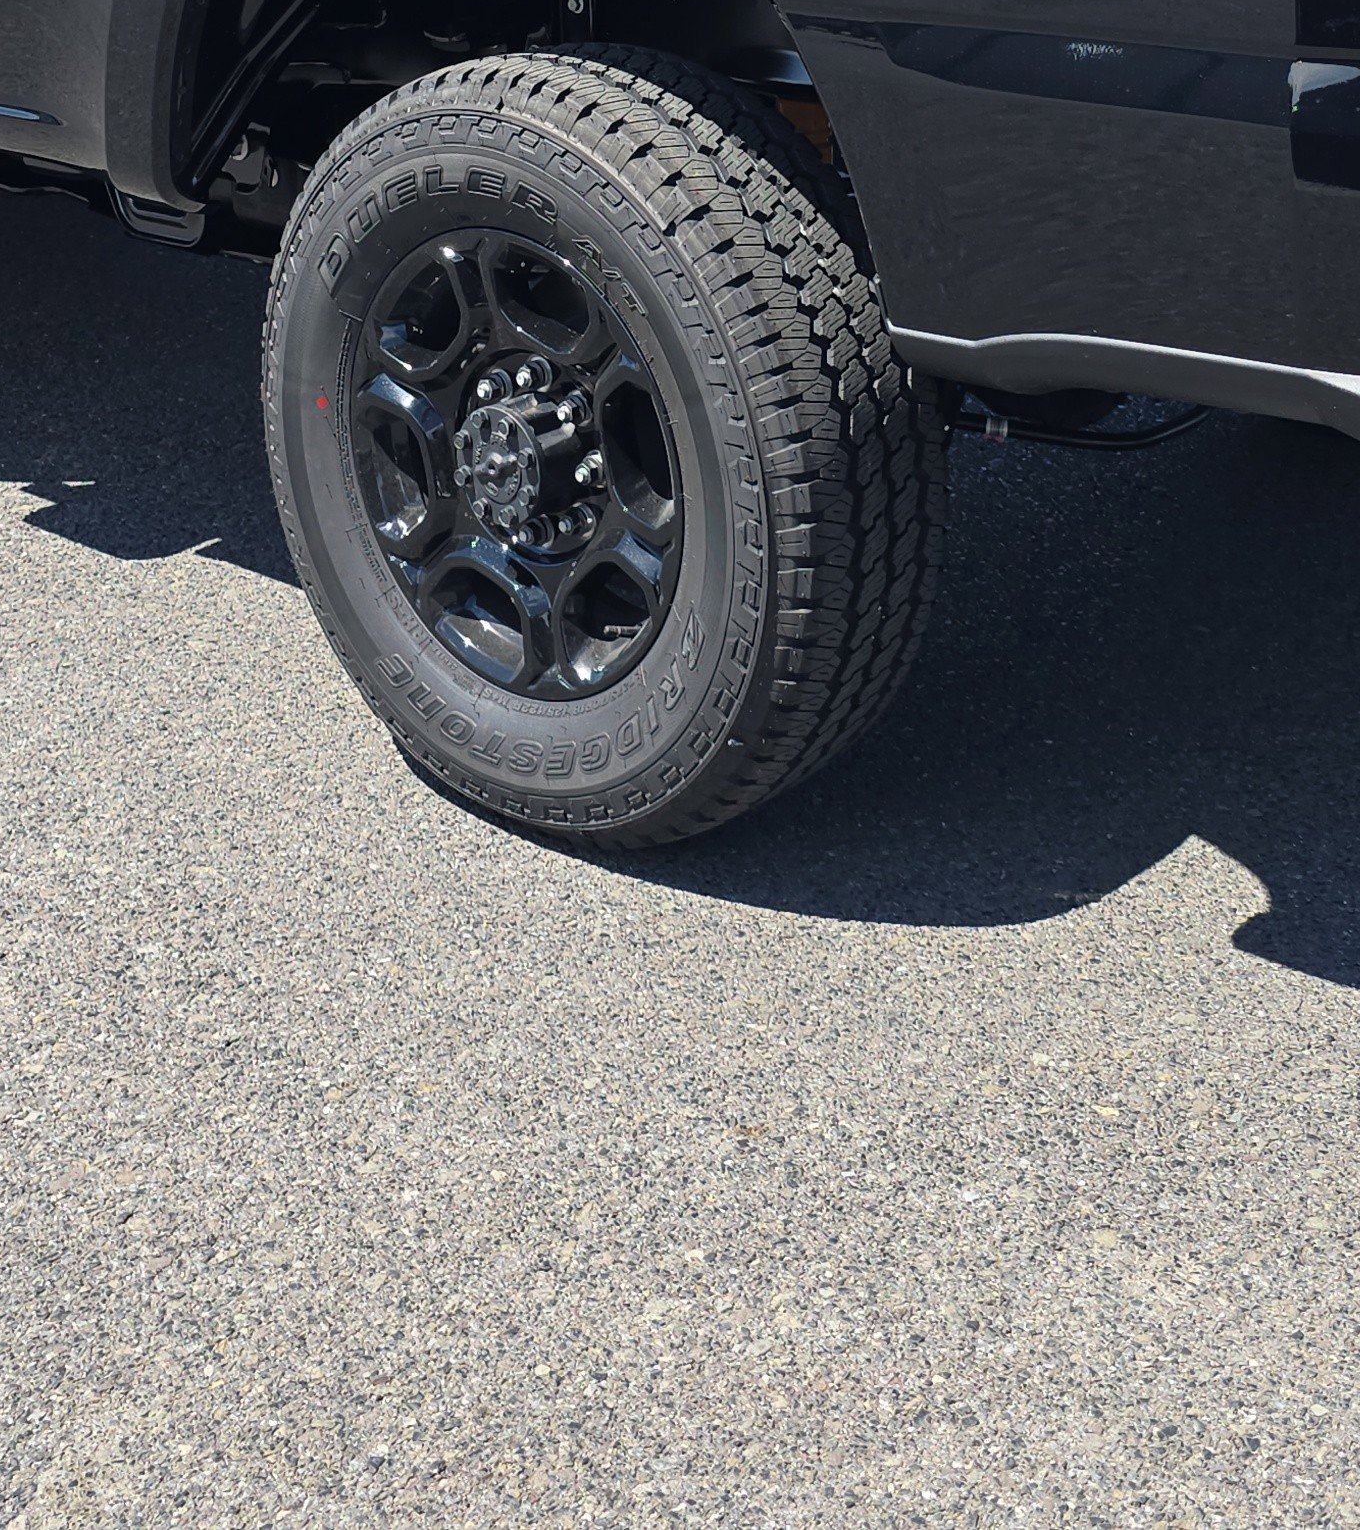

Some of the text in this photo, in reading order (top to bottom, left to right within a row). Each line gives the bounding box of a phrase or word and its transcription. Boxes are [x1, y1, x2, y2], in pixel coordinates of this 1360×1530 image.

[318, 164, 649, 318] DUELER A/T
[374, 604, 706, 779] BRIDGESTONE
